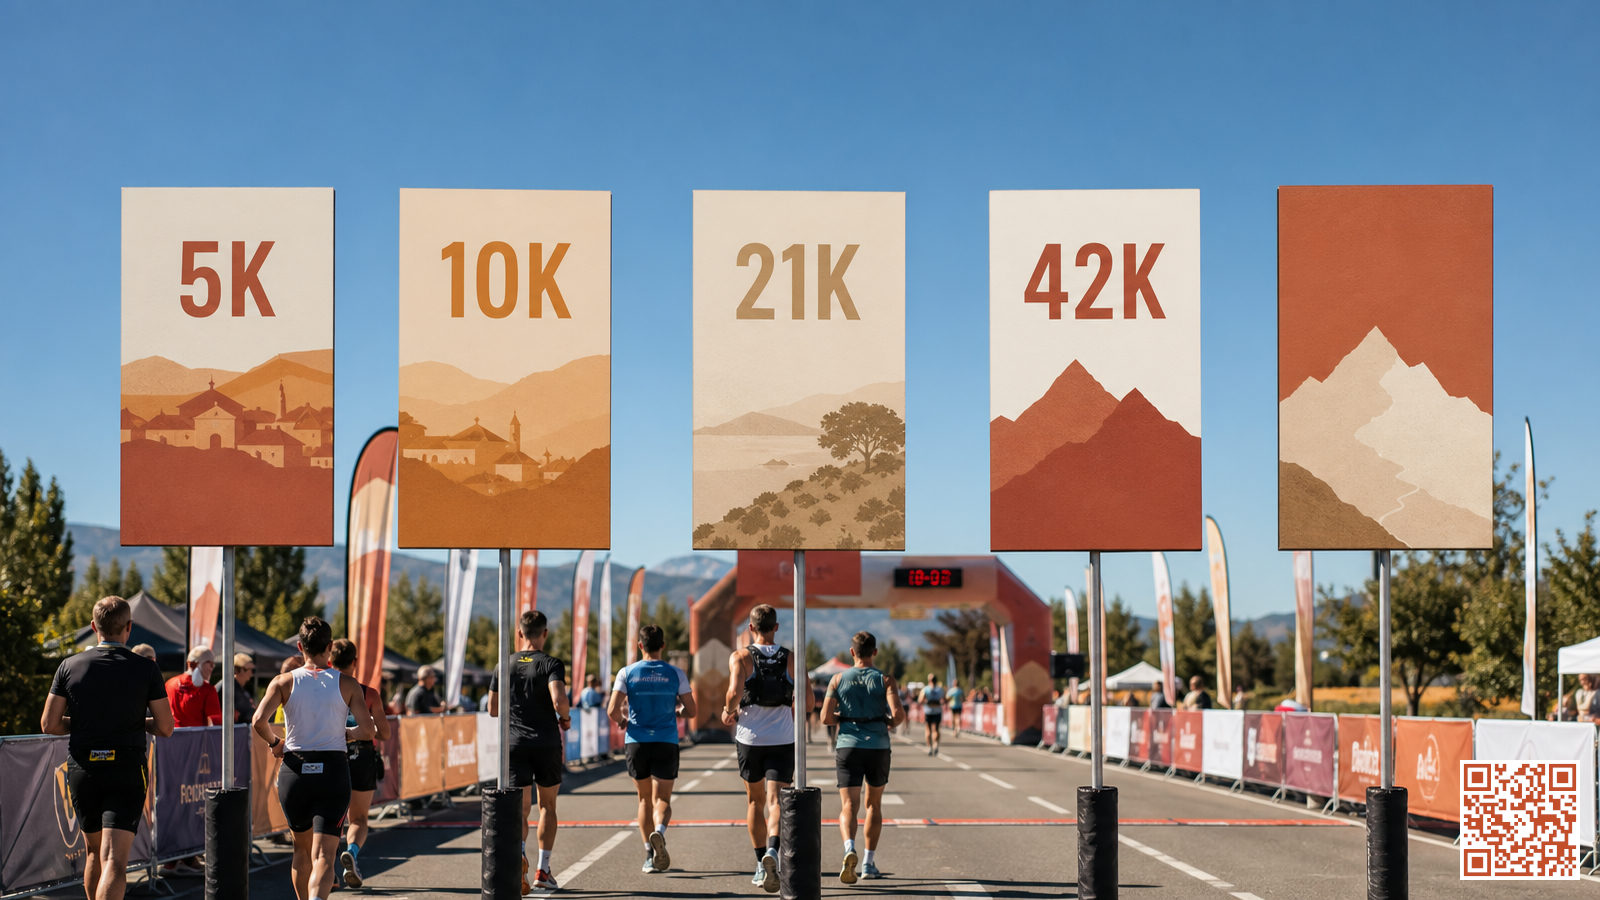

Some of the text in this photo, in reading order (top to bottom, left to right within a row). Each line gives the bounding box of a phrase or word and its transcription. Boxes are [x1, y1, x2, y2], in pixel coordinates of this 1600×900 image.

[180, 241, 276, 318] 5K
[442, 241, 571, 318] 10K
[736, 243, 860, 320] 21K
[1024, 243, 1166, 320] 42K
